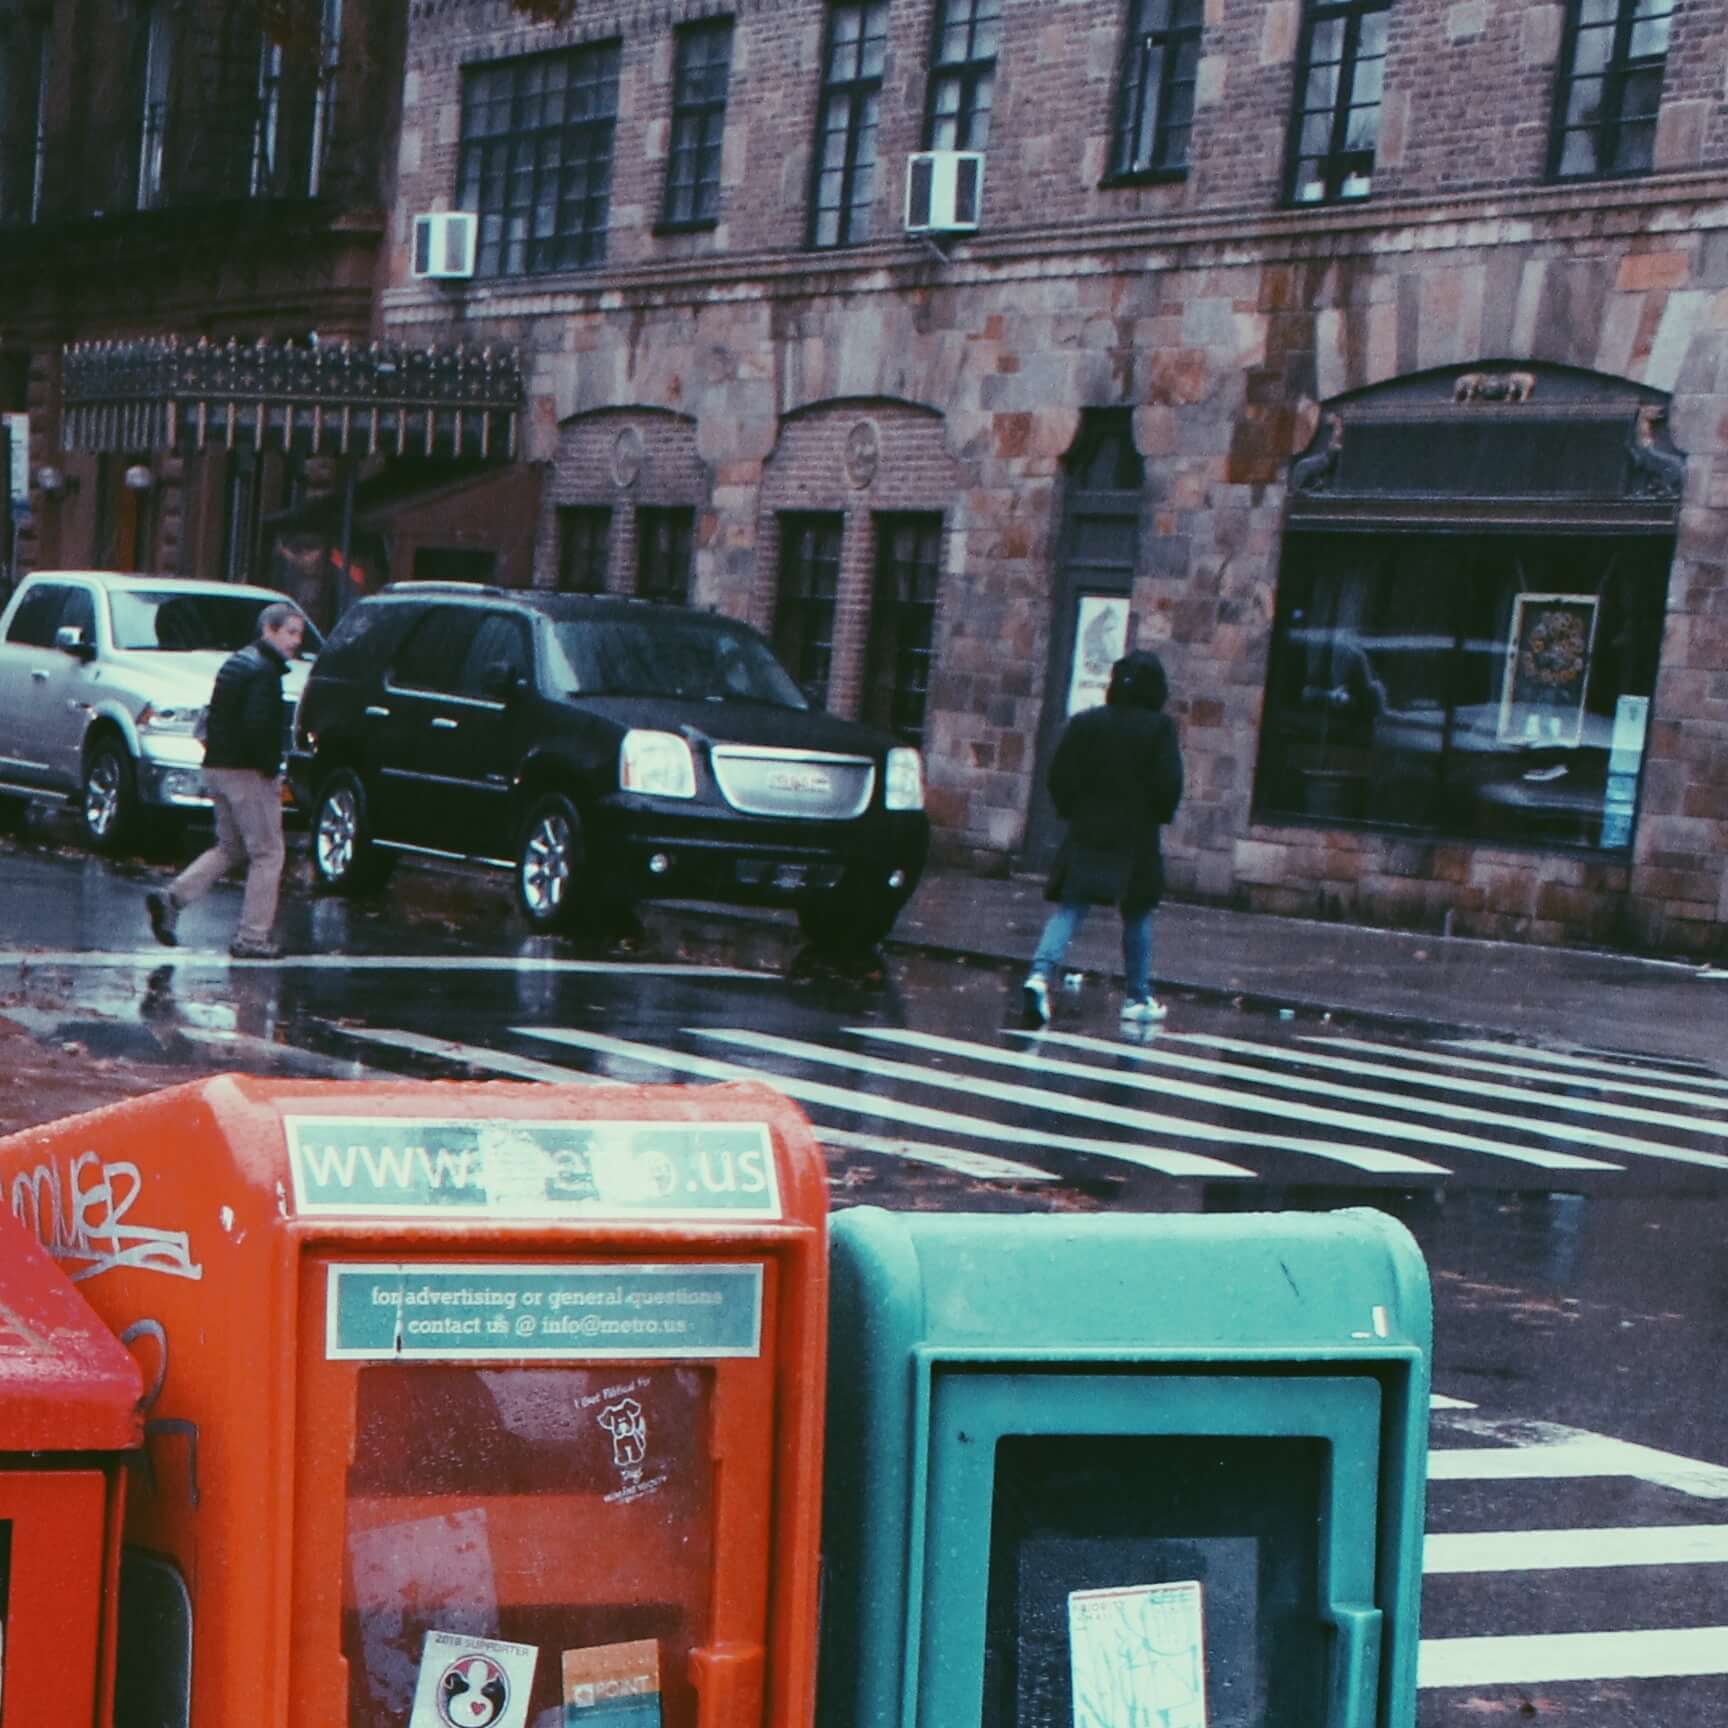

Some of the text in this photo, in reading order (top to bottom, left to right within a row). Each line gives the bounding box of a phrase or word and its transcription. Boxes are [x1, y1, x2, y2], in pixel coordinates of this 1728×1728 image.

[371, 1285, 723, 1310] for advertising or general questions
[407, 1313, 687, 1337] contact us @ info@metro.us
[463, 1636, 530, 1657] SUPPORTER
